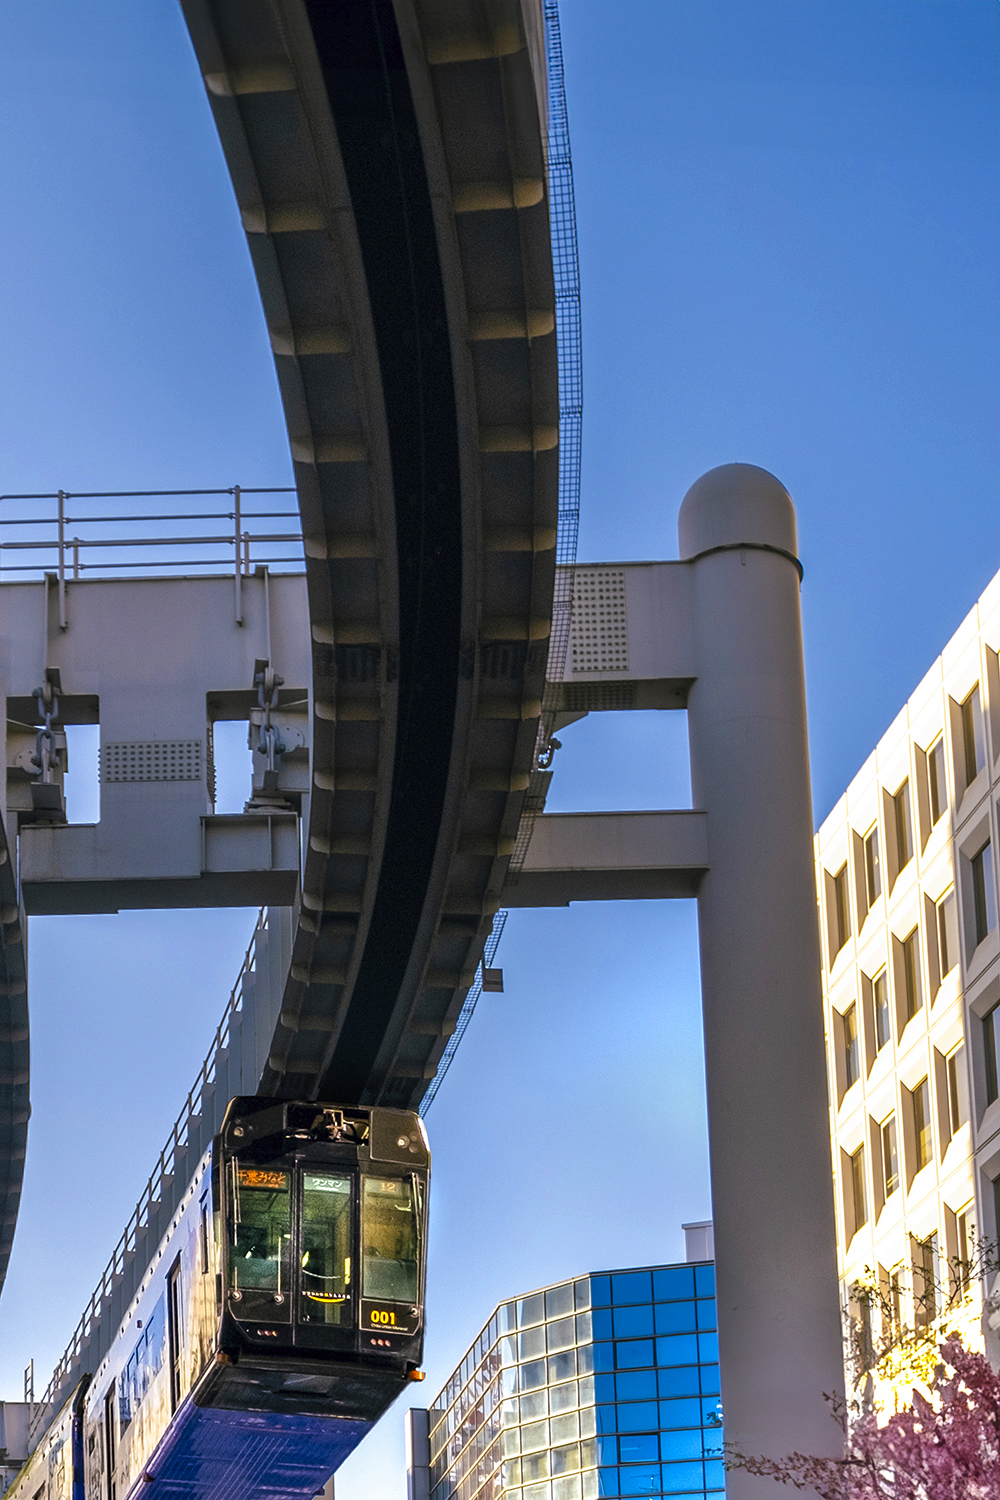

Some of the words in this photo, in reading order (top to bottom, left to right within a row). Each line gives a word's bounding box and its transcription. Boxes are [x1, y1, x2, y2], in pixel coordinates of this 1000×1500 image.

[237, 1169, 286, 1185] 千葉みなと
[312, 1178, 343, 1188] ワンマン
[370, 1310, 396, 1325] 001
